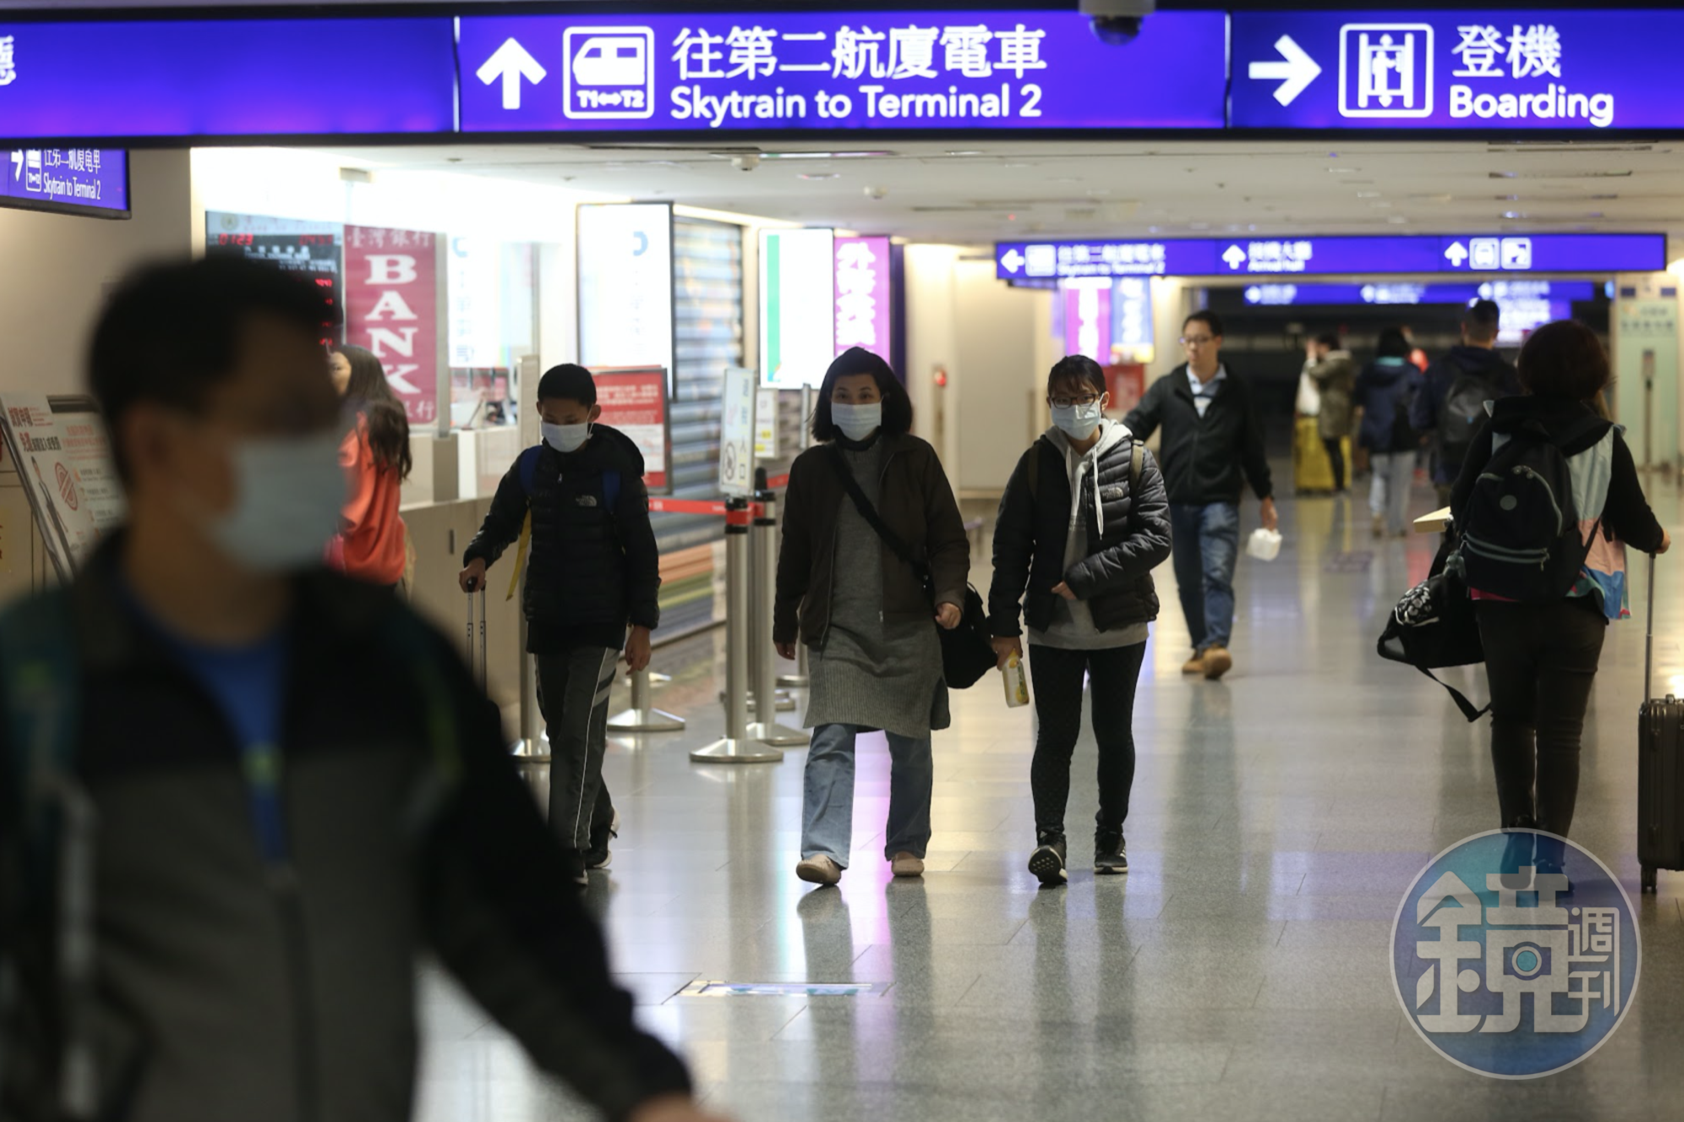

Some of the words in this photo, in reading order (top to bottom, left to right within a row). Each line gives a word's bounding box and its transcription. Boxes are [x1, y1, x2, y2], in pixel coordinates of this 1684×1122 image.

[671, 24, 1047, 80] 往第二航廈電車
[1451, 24, 1561, 79] 登機
[670, 84, 807, 127] Skytrain
[815, 88, 852, 120] to
[864, 85, 1010, 118] Terminal
[1020, 84, 1042, 118] 2
[1449, 83, 1614, 127] Boarding
[43, 172, 66, 200] Skytrain
[66, 178, 73, 196] to
[73, 176, 96, 199] Terminal
[96, 179, 101, 200] 2
[363, 253, 422, 395] BANK
